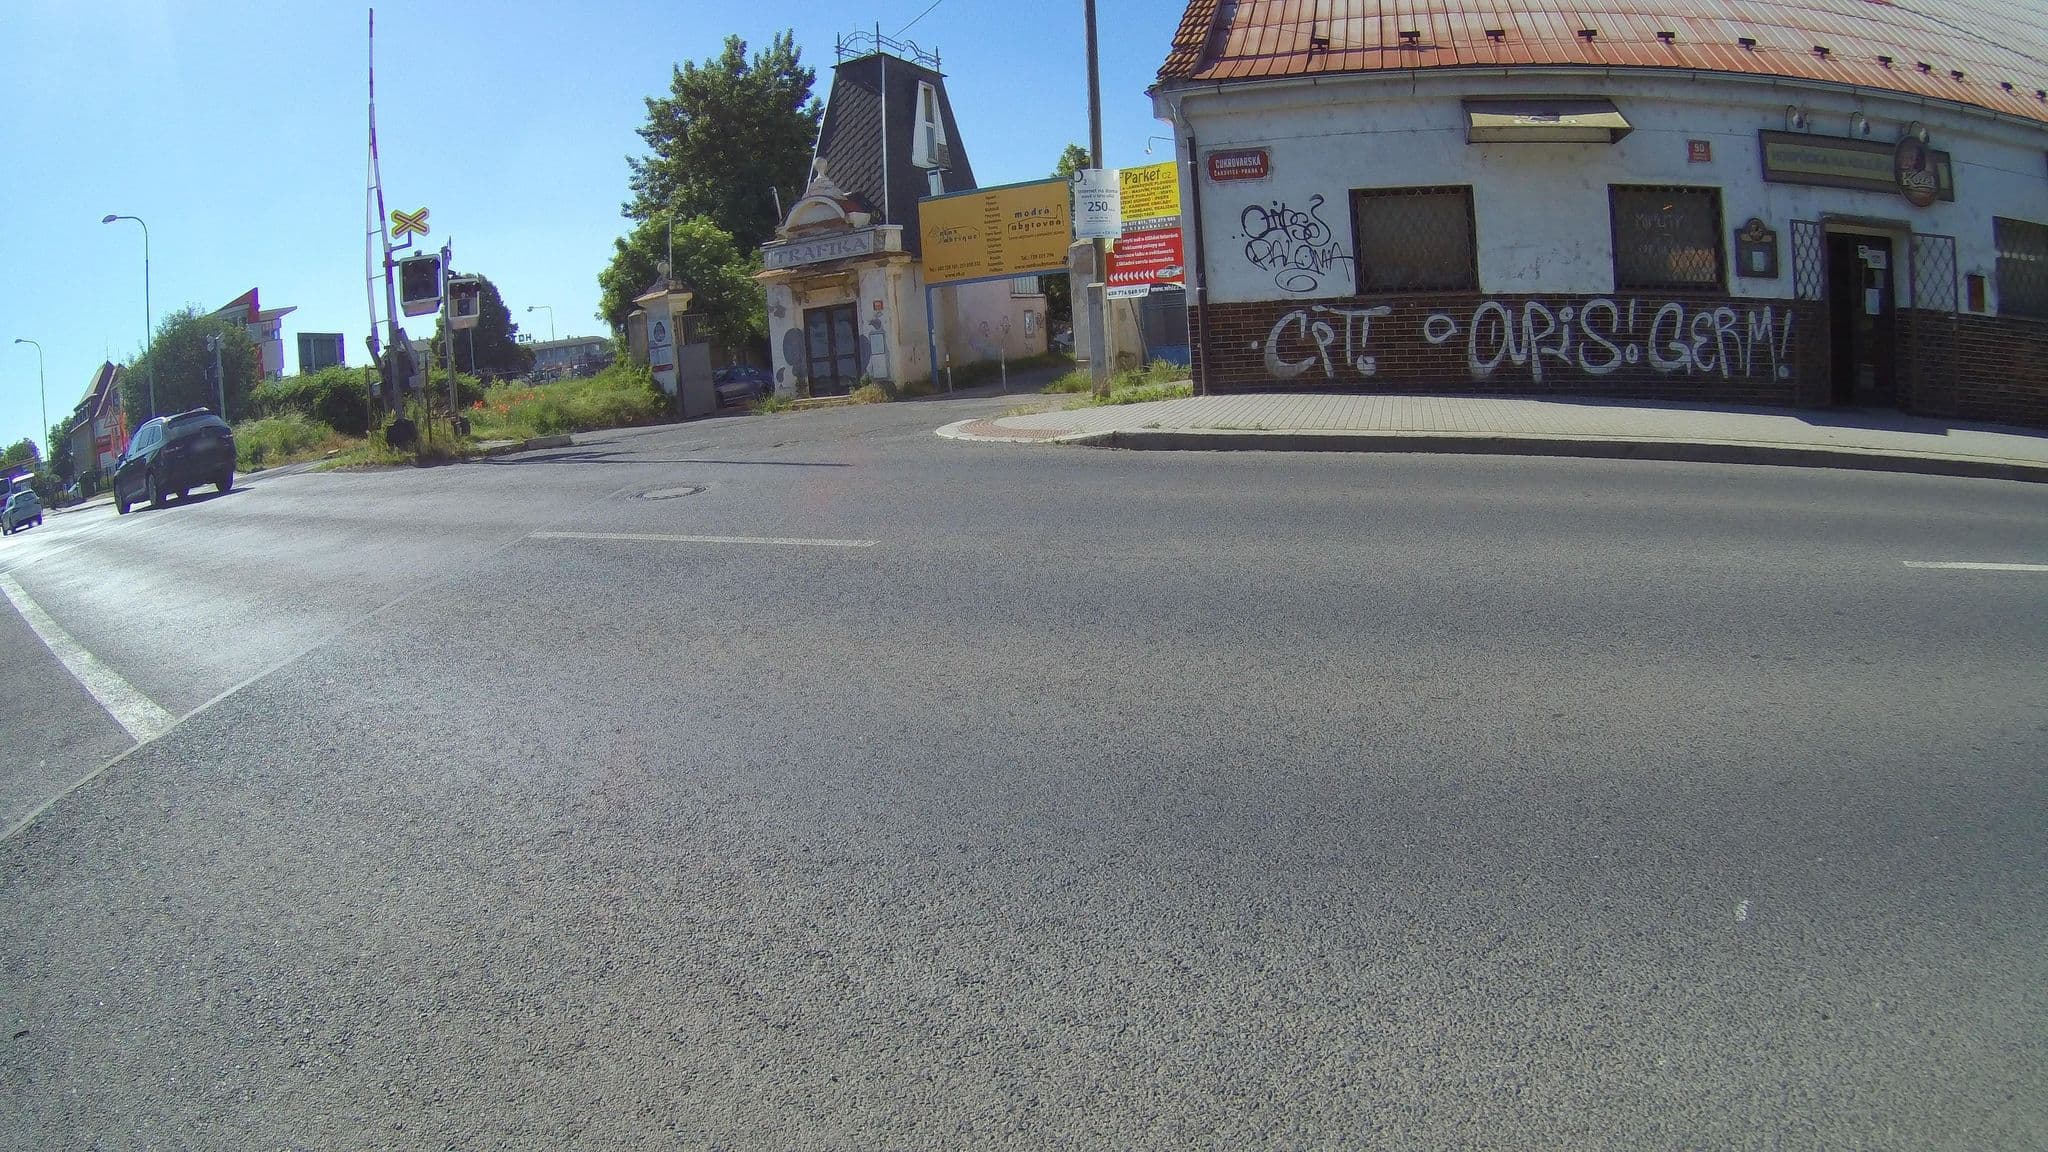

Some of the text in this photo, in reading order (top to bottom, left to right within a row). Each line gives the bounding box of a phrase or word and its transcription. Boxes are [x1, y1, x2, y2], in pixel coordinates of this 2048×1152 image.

[1694, 143, 1705, 152] 90
[1215, 154, 1261, 169] CUKROVARSKÁ
[1125, 168, 1160, 184] Parket
[1087, 201, 1108, 212] 250
[774, 236, 868, 265] TRAFIKA
